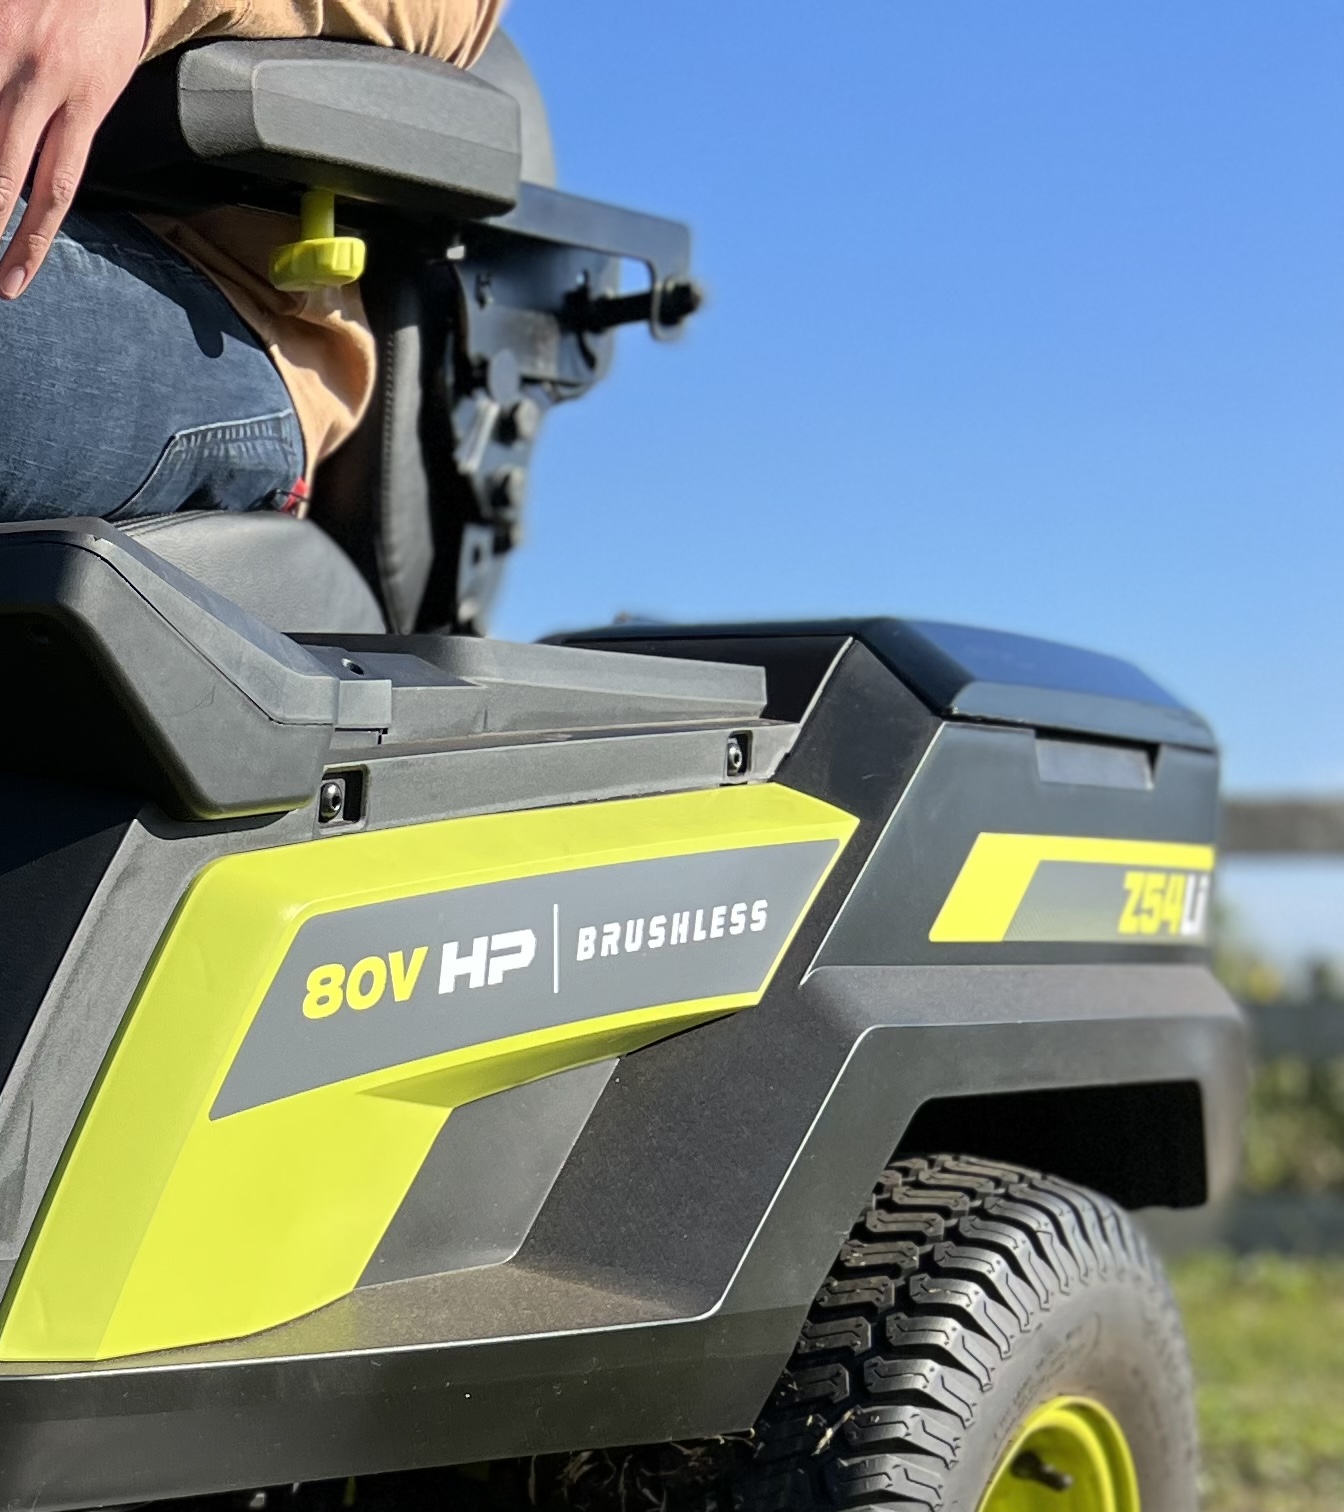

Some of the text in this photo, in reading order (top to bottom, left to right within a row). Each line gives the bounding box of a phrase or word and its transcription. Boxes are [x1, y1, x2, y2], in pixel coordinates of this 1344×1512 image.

[1118, 870, 1209, 935] Z54Li
[302, 899, 768, 1020] 80V HP BRUSHLESS
